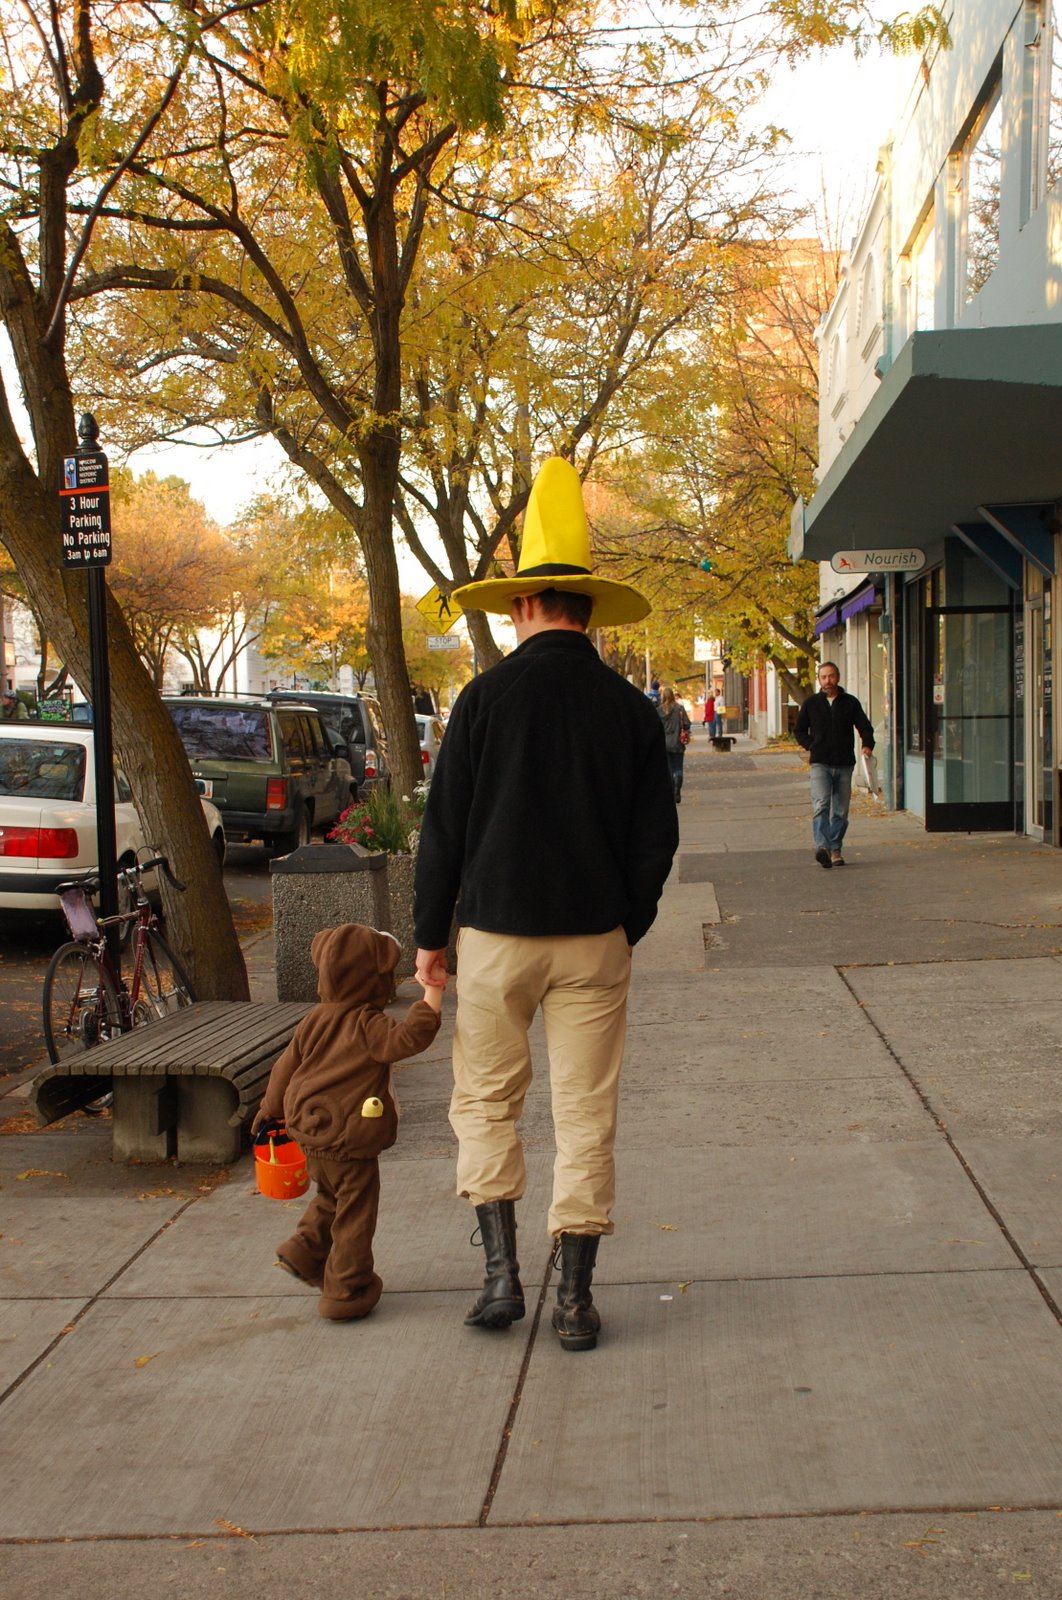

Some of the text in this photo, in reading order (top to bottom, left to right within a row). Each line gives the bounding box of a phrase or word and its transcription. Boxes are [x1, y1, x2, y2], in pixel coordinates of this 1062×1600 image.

[70, 496, 99, 511] 3 Hour
[70, 514, 102, 530] Parking
[63, 531, 110, 547] No Parking
[67, 548, 108, 561] 3am to 6am
[864, 552, 917, 565] Nourish
